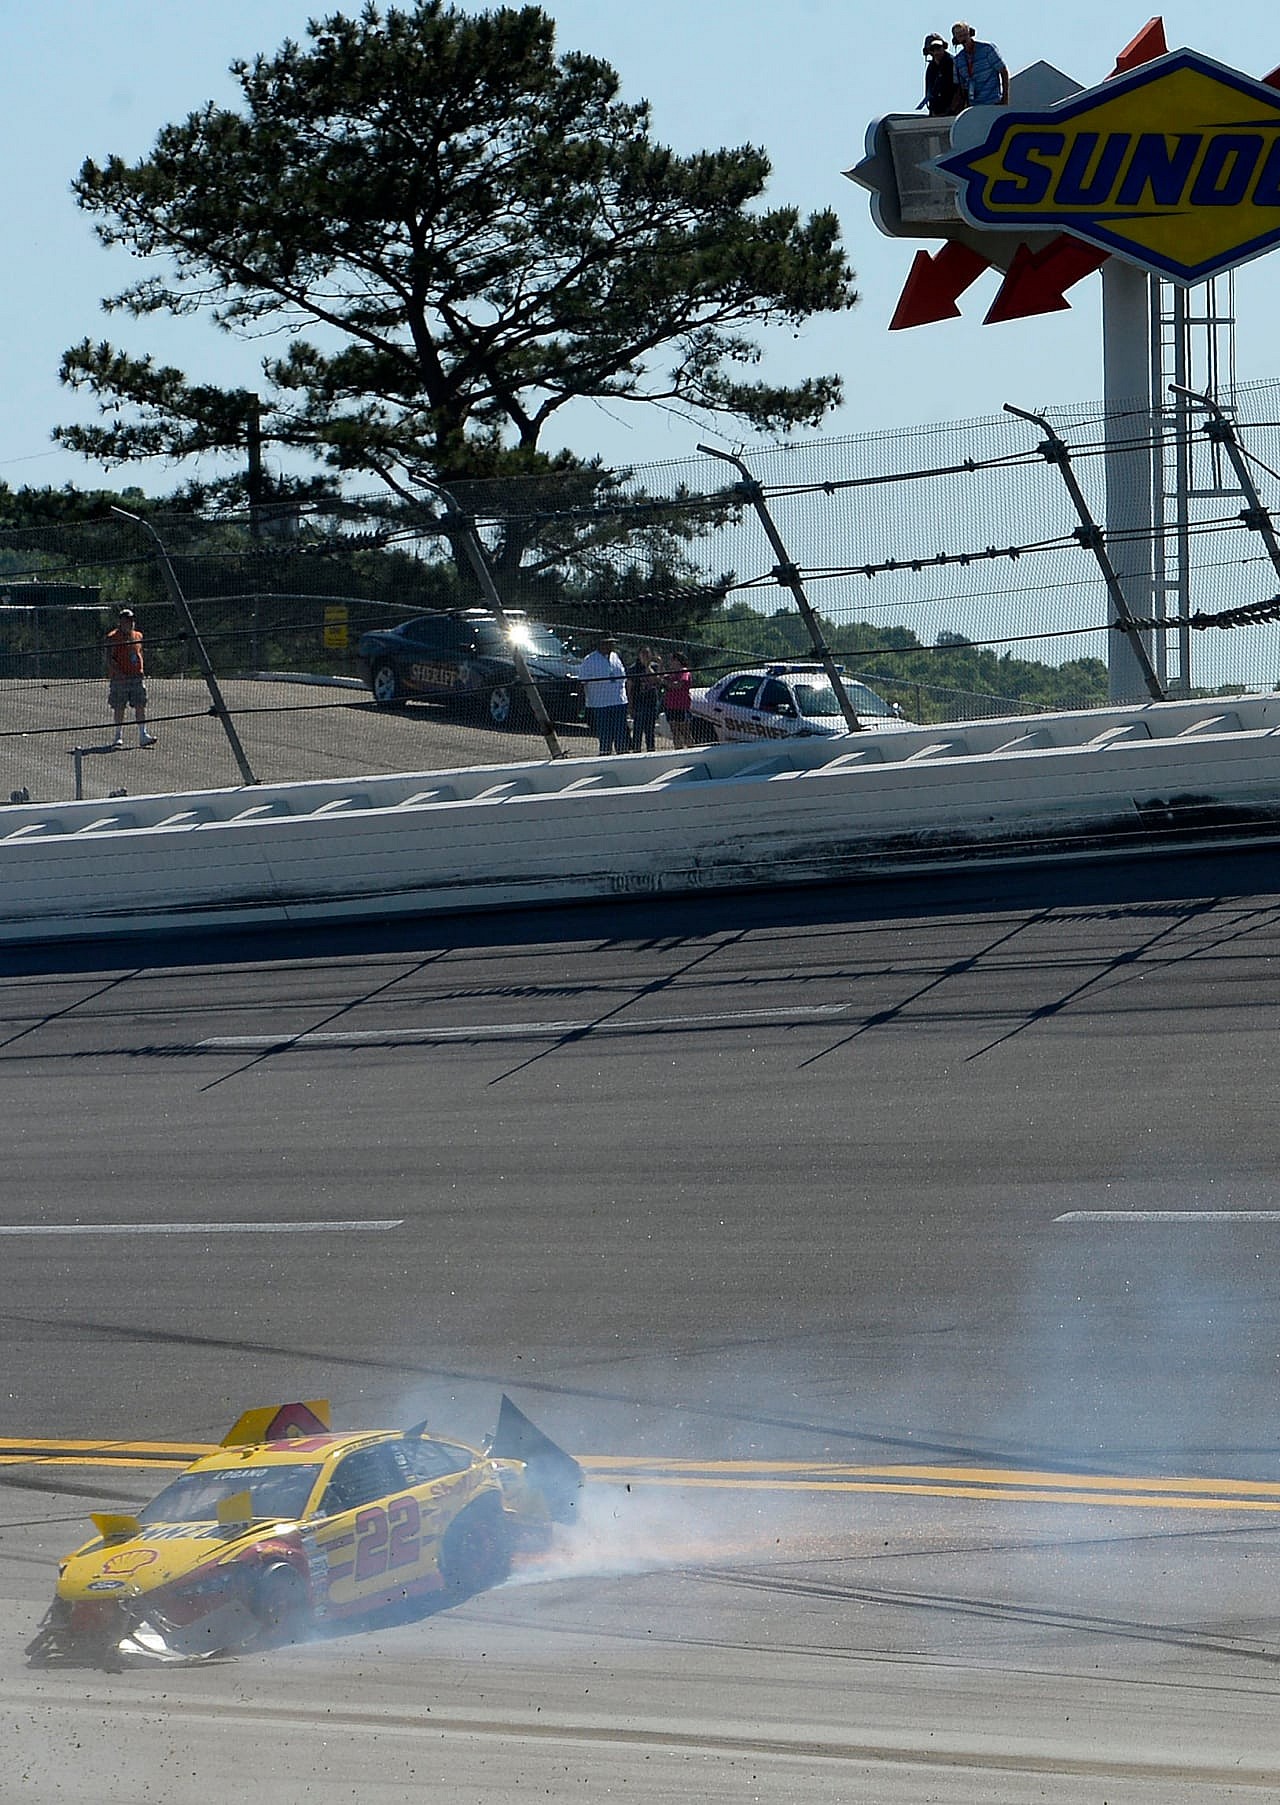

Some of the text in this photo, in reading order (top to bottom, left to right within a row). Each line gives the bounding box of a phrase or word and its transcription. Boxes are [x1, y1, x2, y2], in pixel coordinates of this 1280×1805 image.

[411, 663, 459, 687] SHERIFF
[212, 1467, 269, 1482] LOGANO
[354, 1495, 421, 1583] 22
